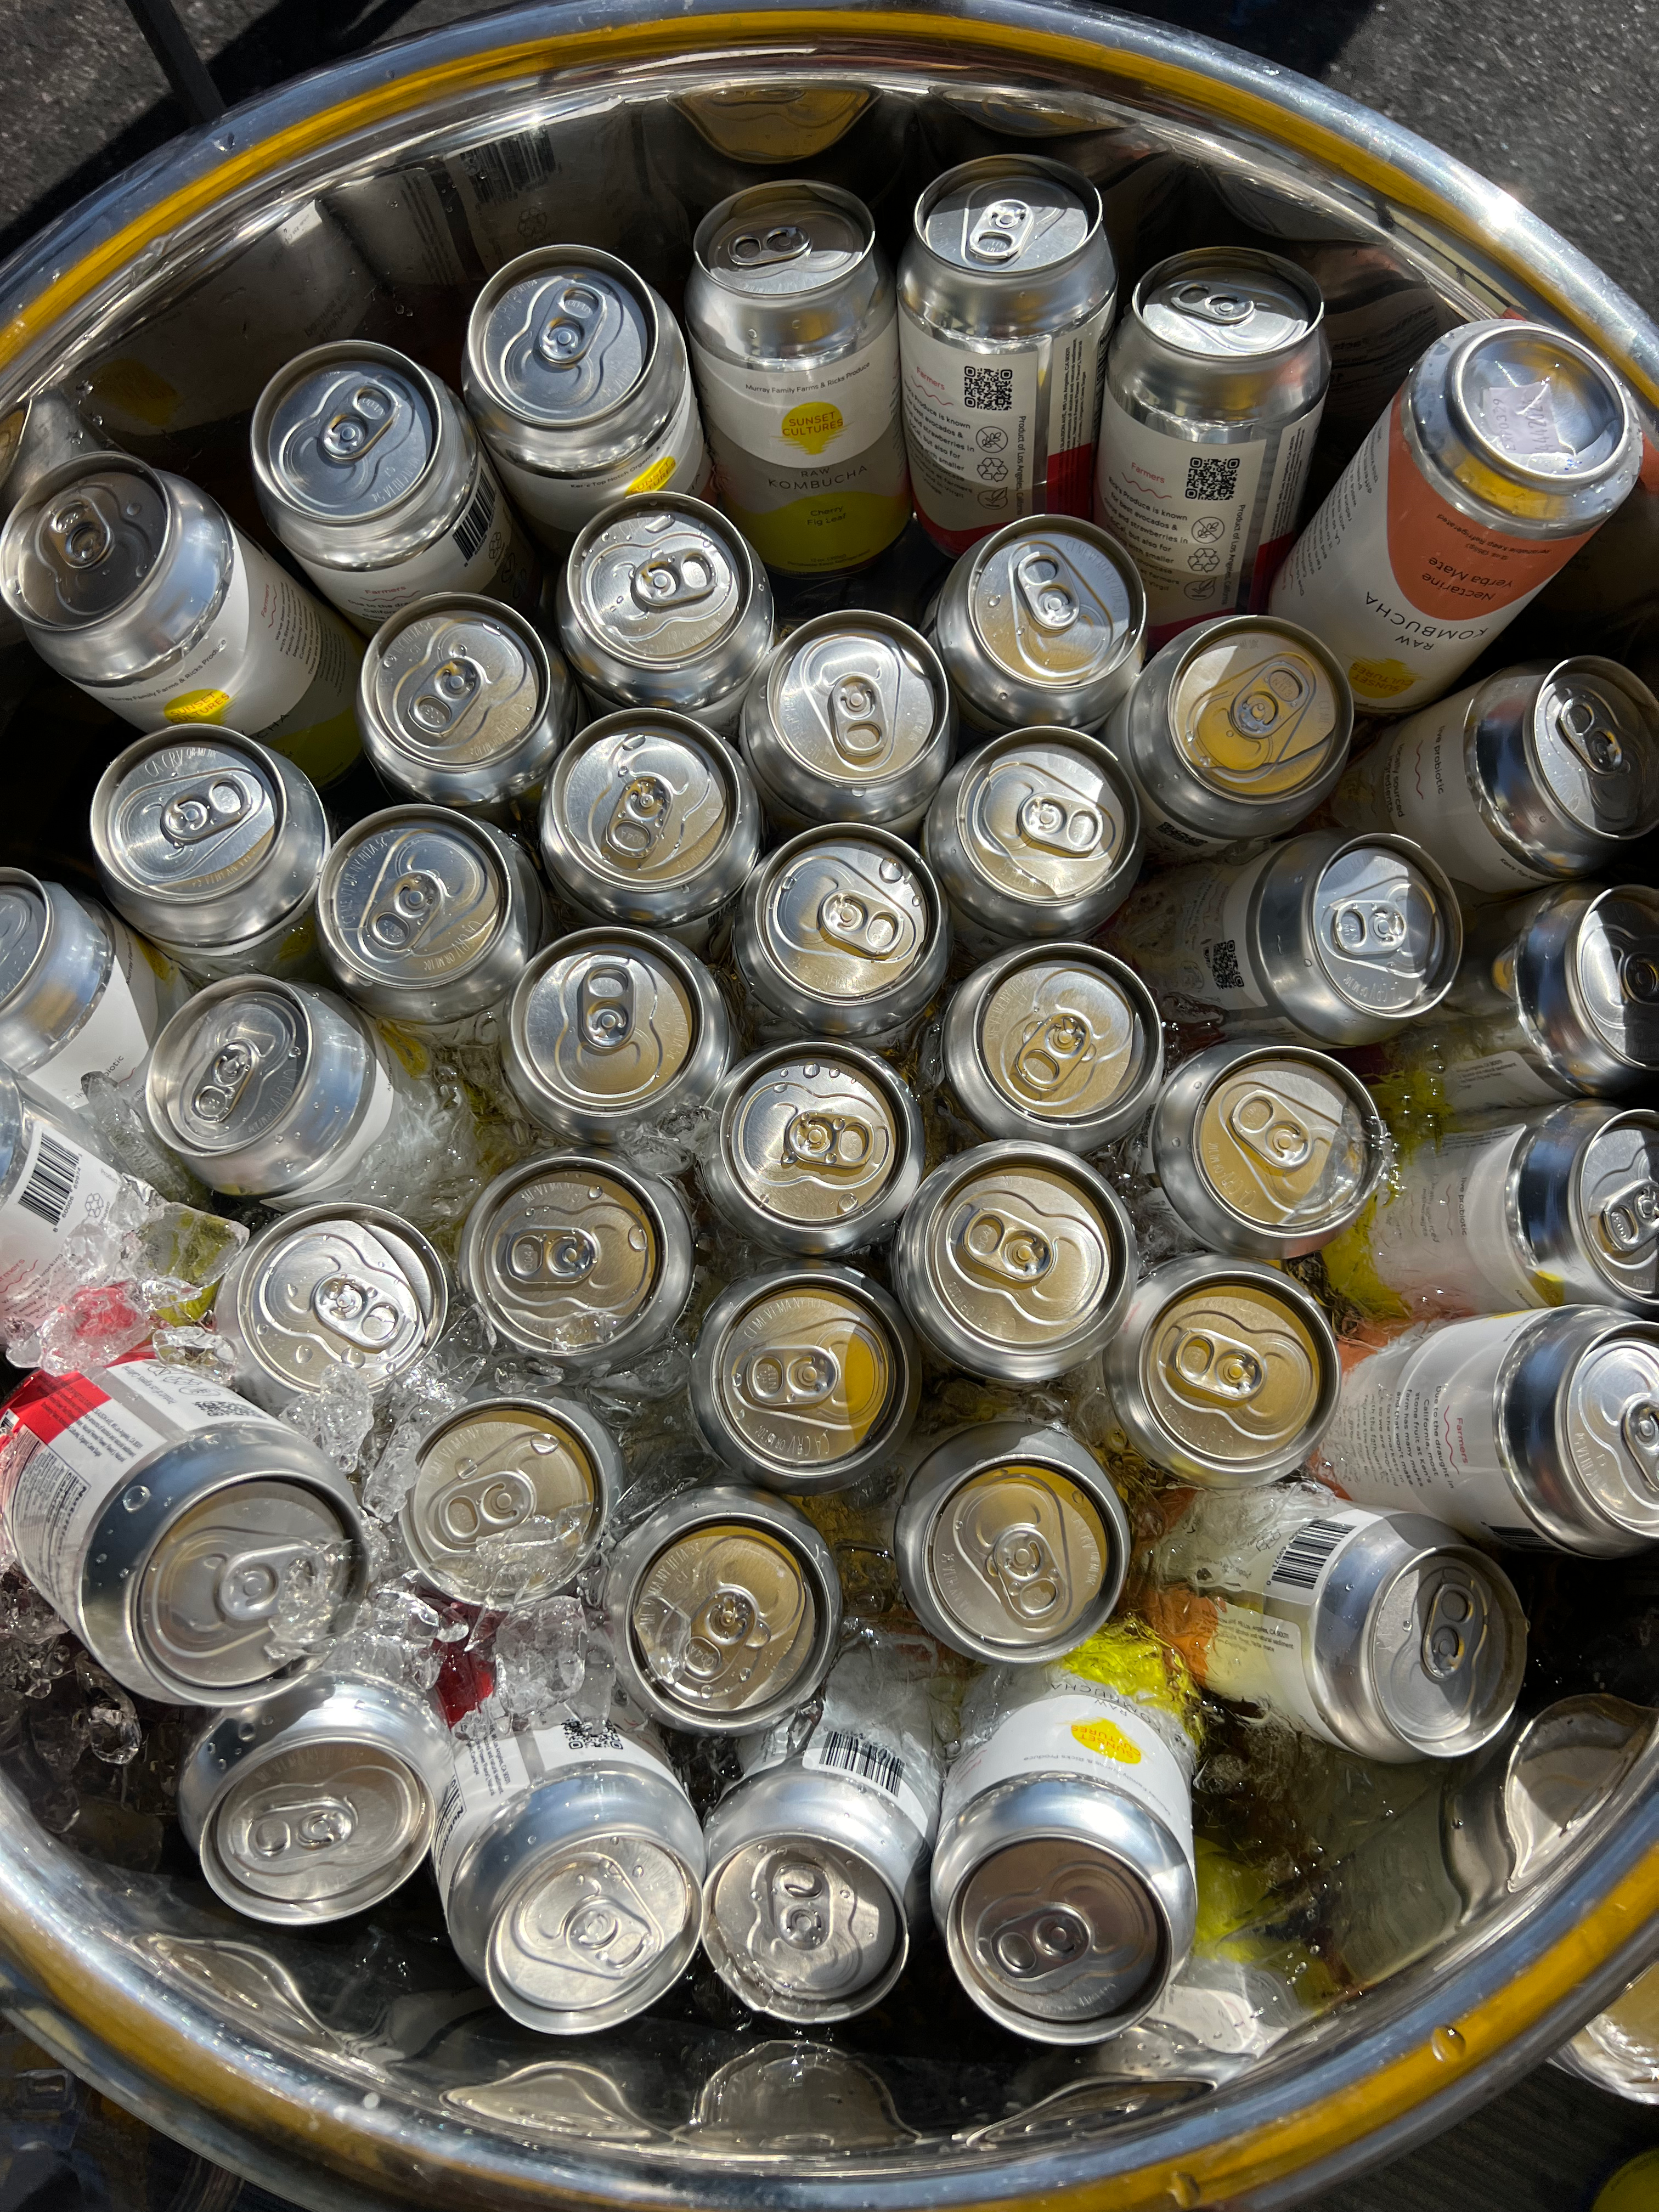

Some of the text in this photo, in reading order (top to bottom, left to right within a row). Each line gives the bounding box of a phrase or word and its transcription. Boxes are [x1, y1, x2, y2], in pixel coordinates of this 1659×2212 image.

[746, 384, 770, 394] Murray
[797, 384, 819, 393] Farms
[846, 362, 871, 379] Produce
[917, 366, 945, 391] Farmers
[782, 418, 844, 437] CULTURES
[788, 411, 836, 427] SUNSET
[924, 415, 955, 436] avocados
[946, 417, 970, 429] known
[1018, 415, 1026, 442] Product
[934, 443, 947, 455] also
[1017, 450, 1026, 463] Los
[607, 470, 629, 483] Notch
[629, 452, 655, 473] Organic
[768, 465, 868, 490] KOMBUCHA
[801, 467, 831, 478] RAW
[1131, 462, 1165, 483] Farmers
[810, 505, 844, 518] Cherry
[1123, 491, 1150, 511] Produce
[1161, 509, 1187, 521] known
[806, 512, 847, 527] Fig Leaf
[1135, 511, 1169, 529] avocados
[1234, 504, 1246, 531] Product
[1131, 520, 1177, 542] strawberries
[1142, 539, 1157, 548] also
[1230, 541, 1239, 553] Los
[1146, 551, 1175, 563] smaller
[1428, 557, 1514, 588] Yerba Mate
[365, 586, 407, 595] Farmers
[1422, 573, 1496, 601] Nectarine
[1364, 590, 1488, 640] KOMBUCHA
[1395, 635, 1436, 652] RAW
[156, 682, 179, 695] Farms
[185, 664, 204, 679] Ricks
[201, 639, 227, 665] Produce
[1350, 662, 1414, 687] CULTURES
[1351, 672, 1403, 693] SUNSET
[170, 691, 216, 717] SUNSET
[171, 693, 230, 724] CULTURES
[1432, 744, 1446, 795] probiotic
[61, 1196, 75, 1218] 60006
[1457, 1193, 1468, 1237] probiotic
[1404, 1389, 1413, 1410] farm
[1434, 1386, 1442, 1404] Due
[1433, 1407, 1438, 1418] to
[1404, 1432, 1413, 1457] many
[1417, 1446, 1423, 1456] at
[1457, 1418, 1468, 1464] Farmers
[1401, 1461, 1413, 1485] make
[1410, 1460, 1424, 1487] marks
[1419, 1459, 1432, 1483] Ken's
[1427, 1452, 1438, 1476] most
[1447, 1480, 1454, 1488] in
[1094, 1699, 1127, 1716] RAW
[1079, 1734, 1134, 1759] SUNSET
